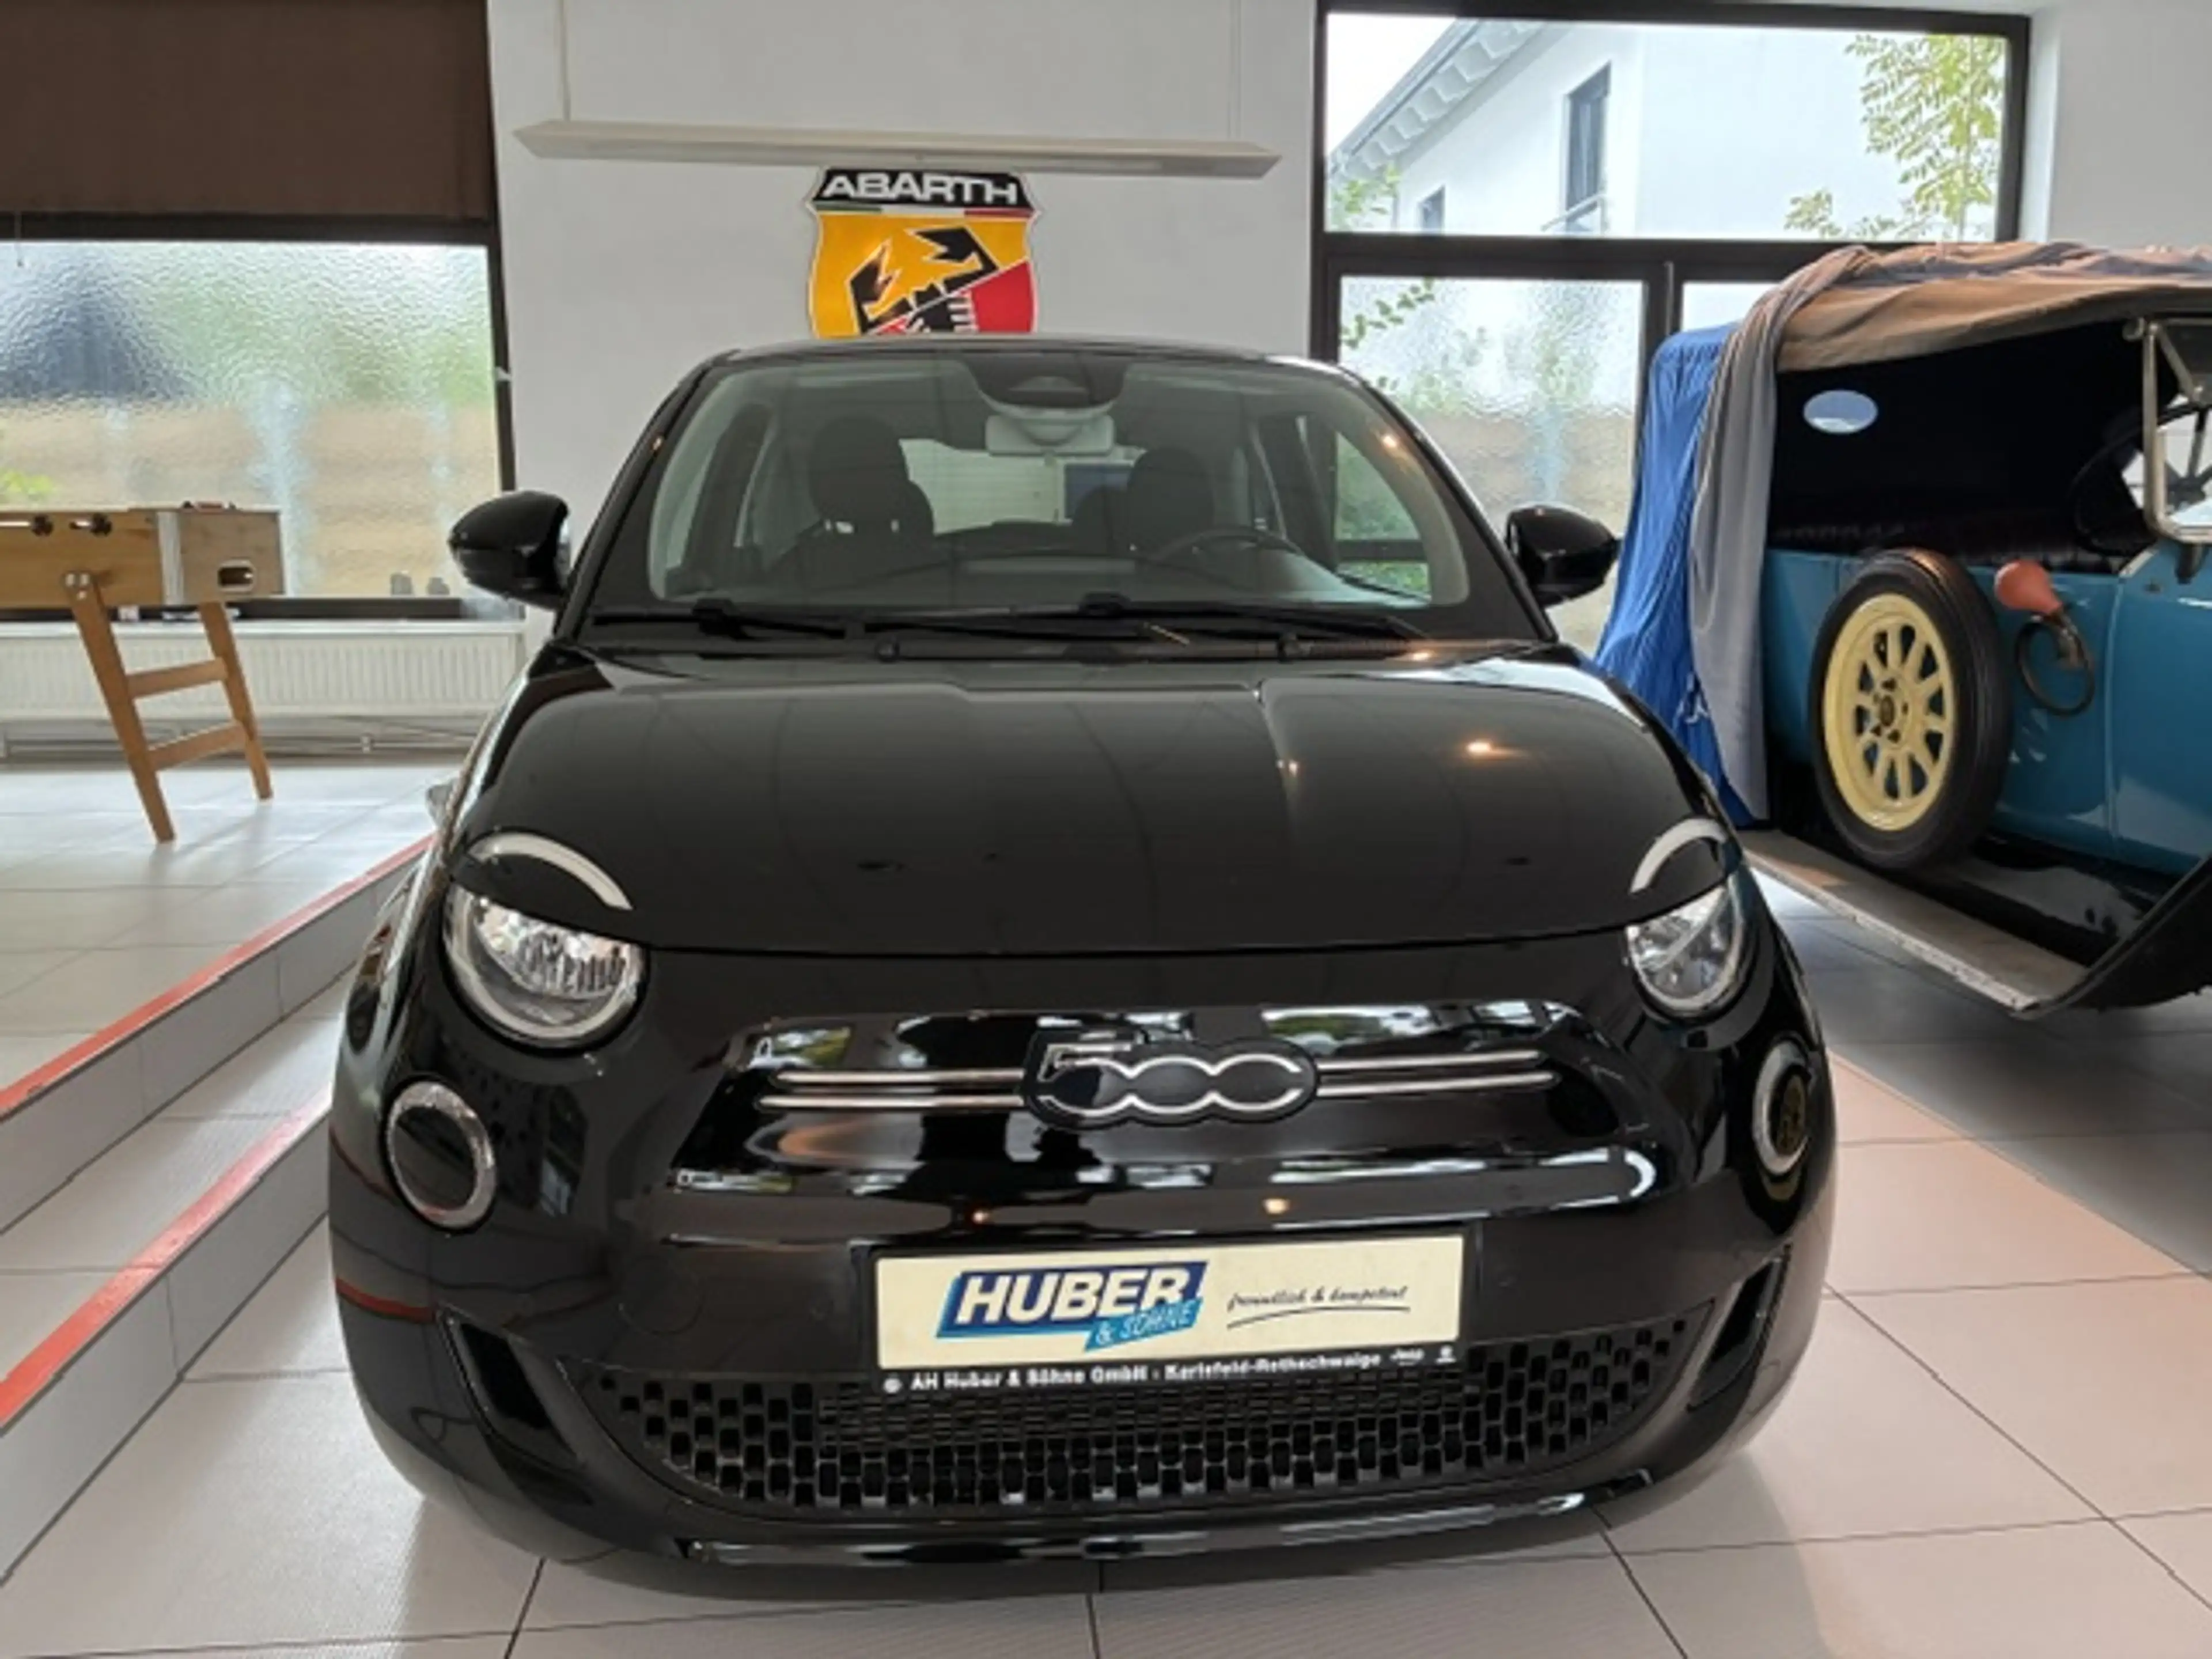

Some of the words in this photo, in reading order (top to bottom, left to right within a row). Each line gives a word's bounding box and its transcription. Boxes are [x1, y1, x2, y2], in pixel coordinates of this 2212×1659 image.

[823, 172, 1018, 205] ABARTH
[1037, 1042, 1303, 1118] 500
[956, 1268, 1191, 1324] HUBER
[1096, 1320, 1115, 1346] &
[1119, 1298, 1196, 1339] SÖHNE
[910, 1372, 938, 1391] AH
[943, 1370, 1003, 1389] Huber
[1006, 1368, 1021, 1387] &
[1026, 1366, 1086, 1385] Söhne
[1090, 1363, 1149, 1383] GmbH
